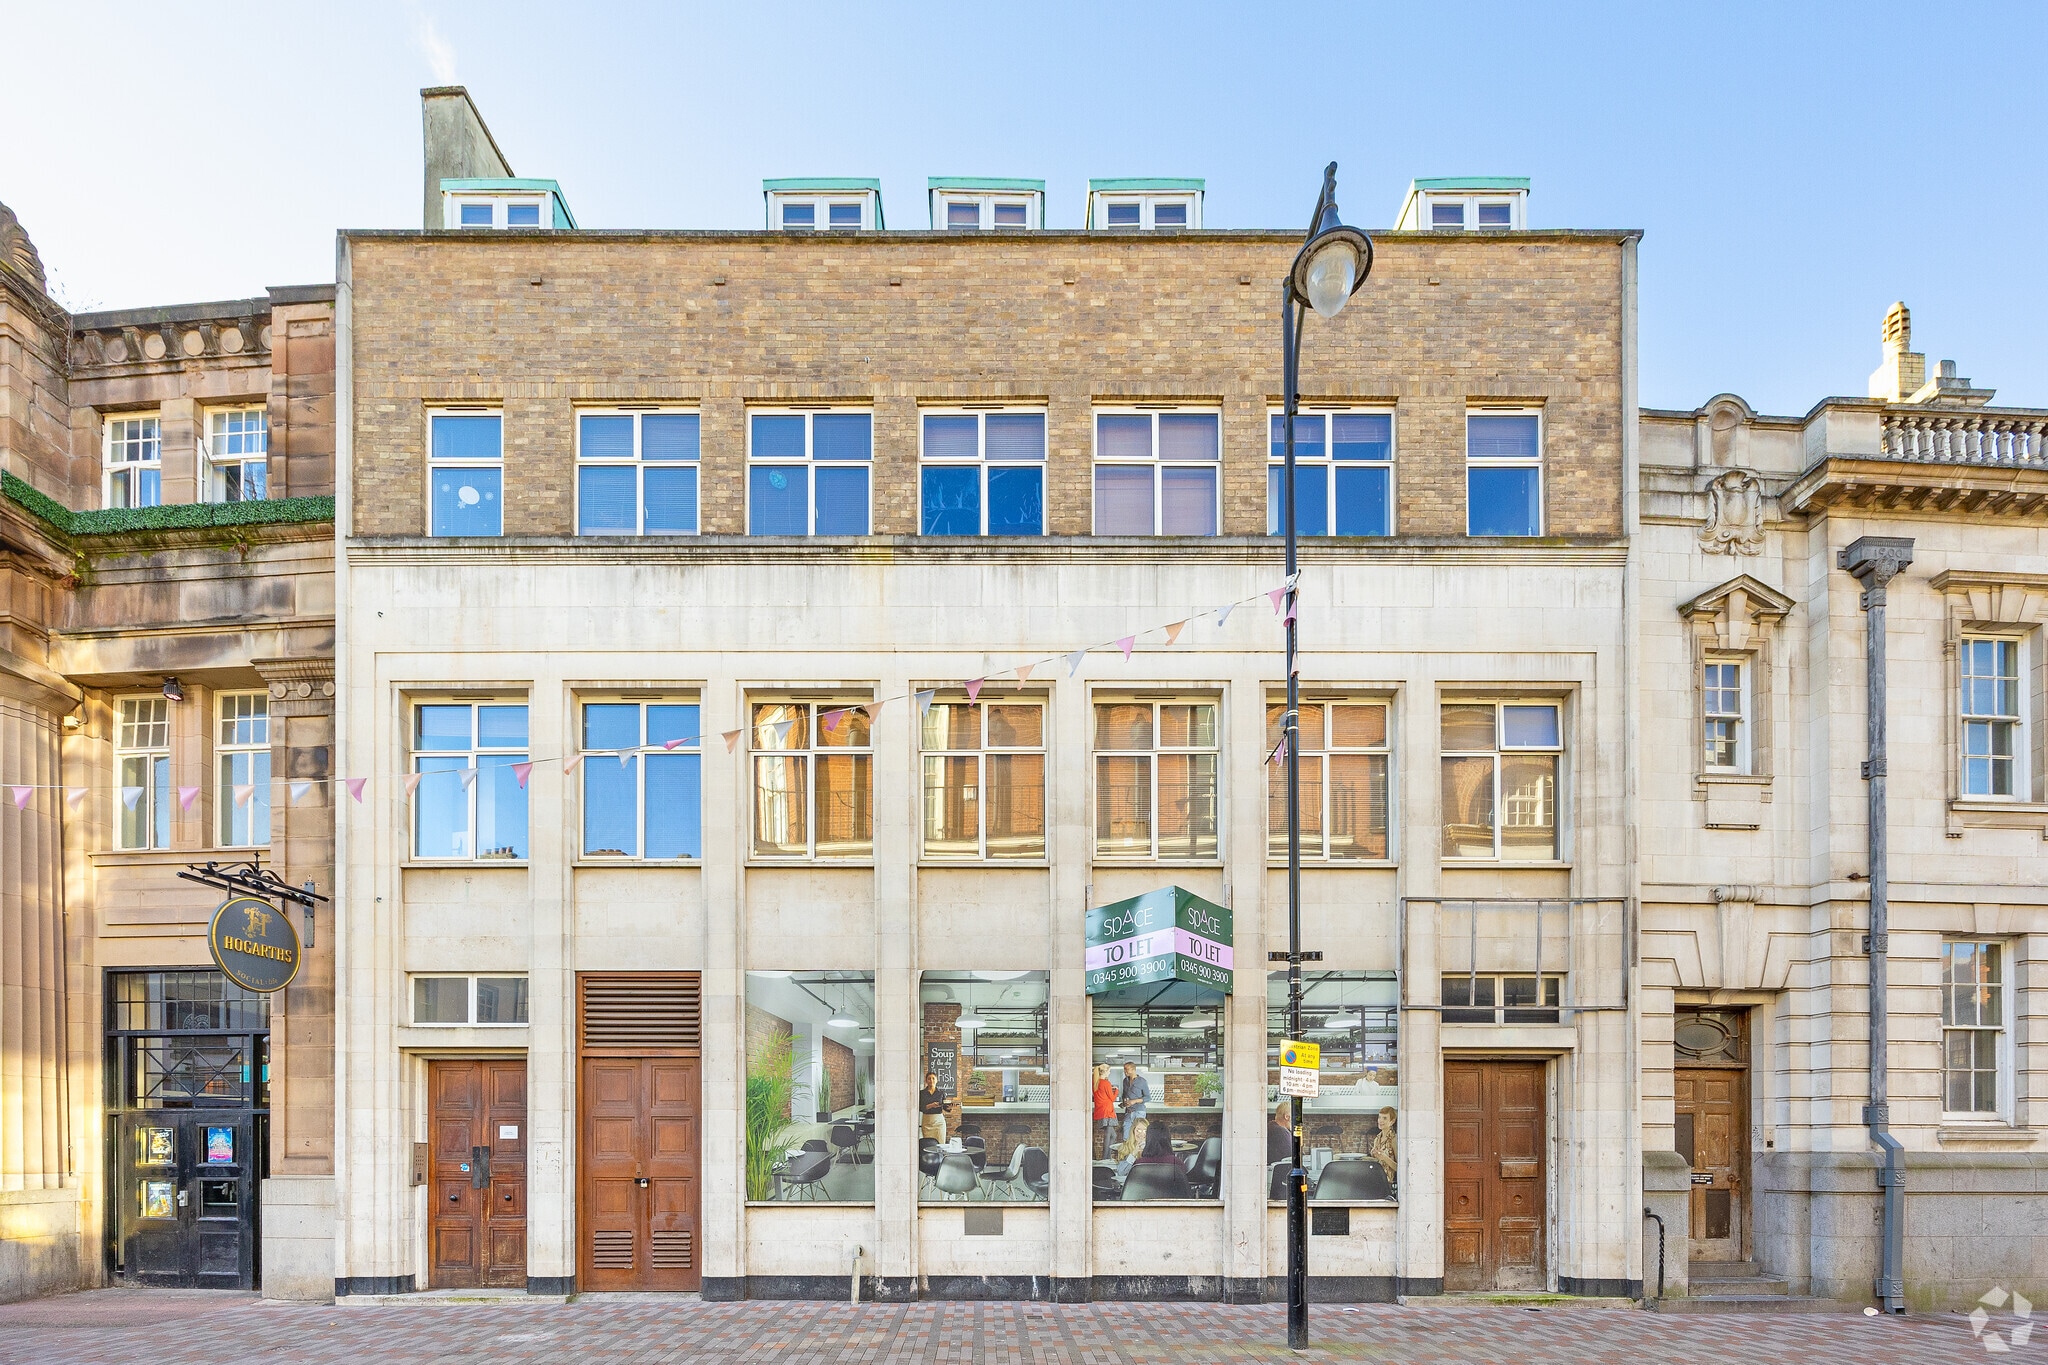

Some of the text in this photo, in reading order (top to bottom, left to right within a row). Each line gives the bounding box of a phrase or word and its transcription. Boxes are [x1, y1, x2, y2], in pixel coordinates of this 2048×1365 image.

[224, 935, 292, 963] HOGARTHS
[1104, 937, 1154, 963] TO LET
[1188, 937, 1221, 963] TO LET
[1093, 971, 1117, 985] 0345
[1119, 966, 1138, 980] 900
[1140, 959, 1166, 974] 3900
[1180, 959, 1198, 975] 0345
[1198, 964, 1211, 978] 900
[1212, 969, 1229, 984] 3900
[931, 1047, 954, 1061] Soup
[938, 1068, 954, 1082] Fish
